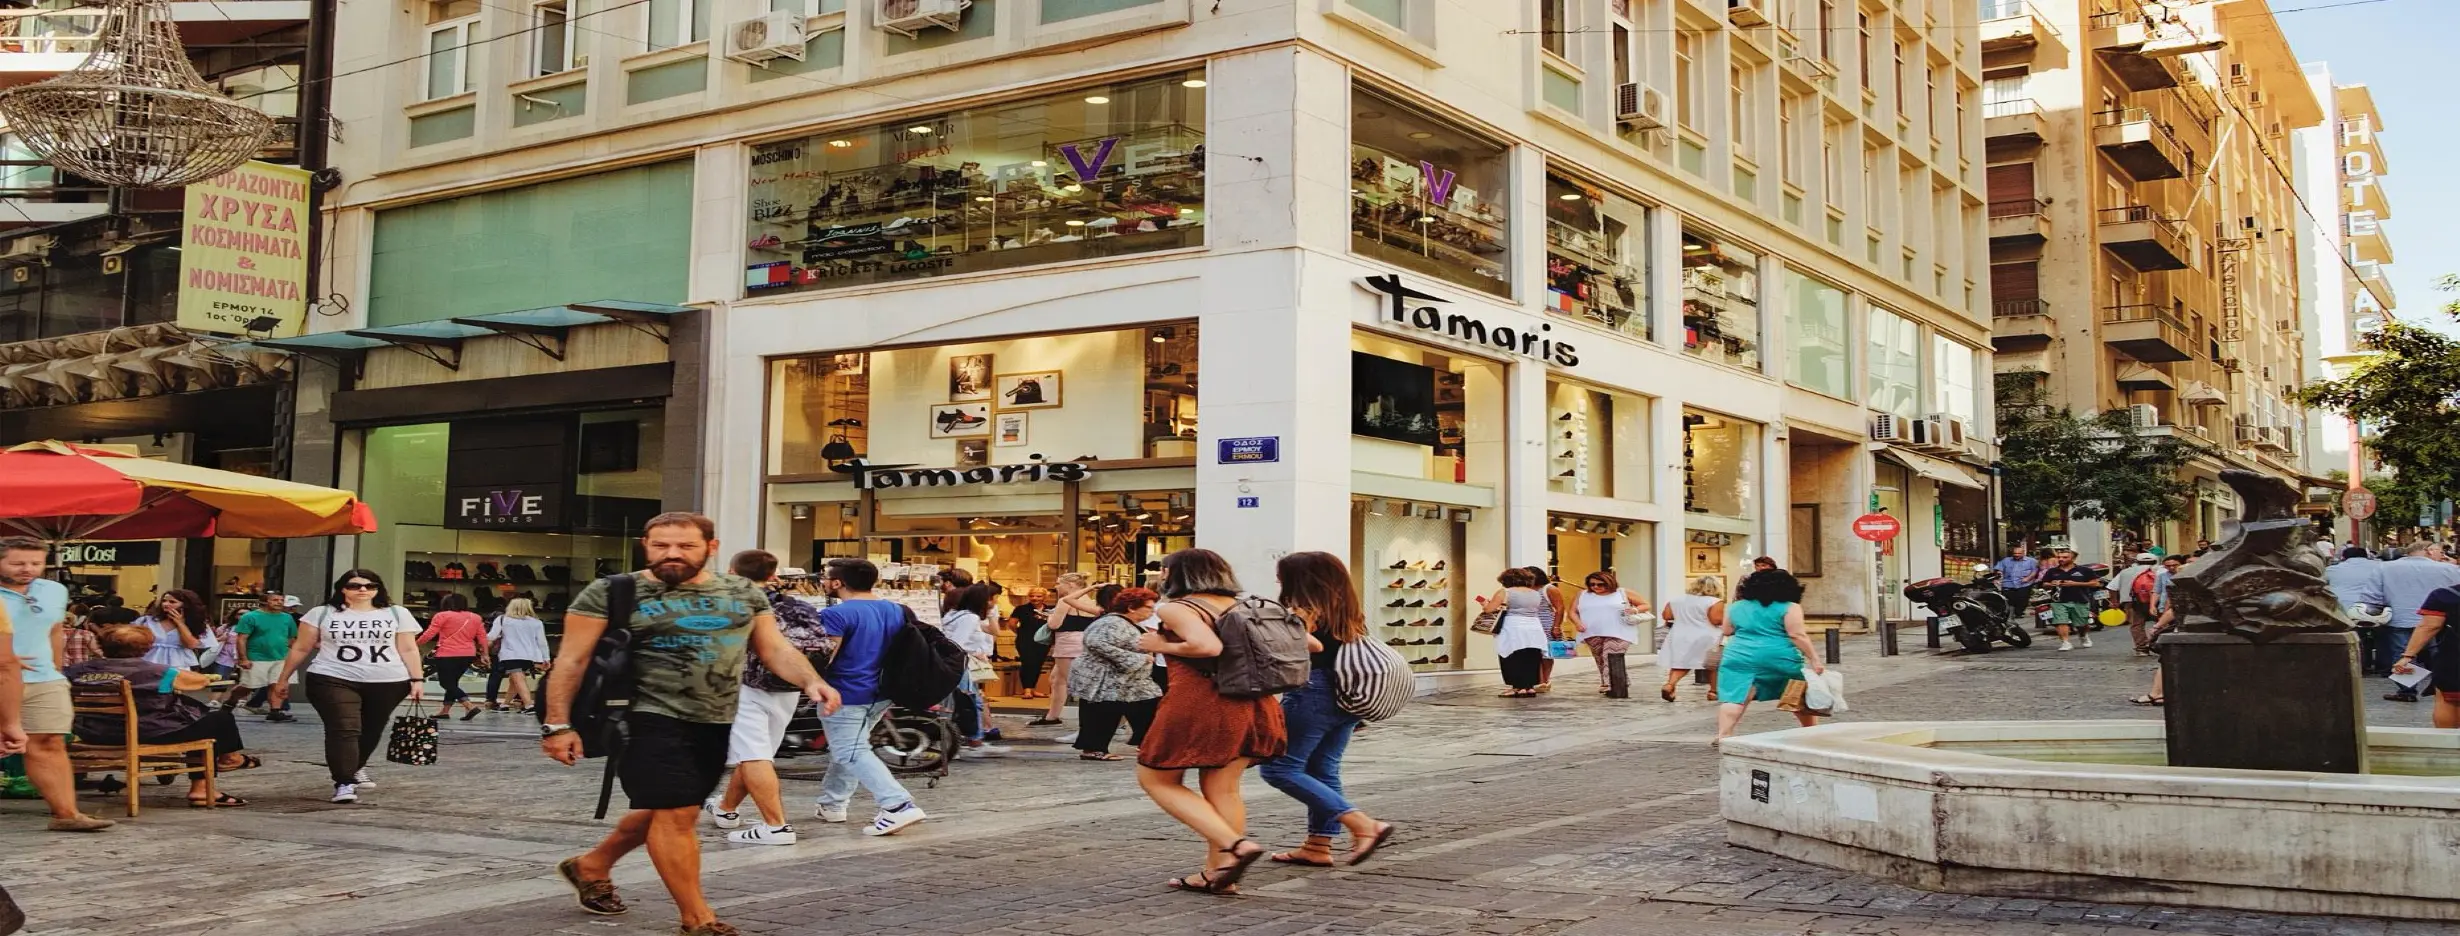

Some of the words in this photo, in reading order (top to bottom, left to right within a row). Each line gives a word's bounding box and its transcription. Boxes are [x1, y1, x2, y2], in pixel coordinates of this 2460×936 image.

[752, 147, 801, 167] MOSCHINO
[2344, 113, 2379, 267] HOTEL
[199, 193, 298, 233] ΧΡΥΣΑ
[754, 204, 793, 222] BIZZ
[191, 224, 302, 260] ΚΟΣΜΗΜΑΤΑ
[237, 256, 257, 271] &
[890, 258, 953, 274] LACOSTE
[189, 267, 300, 301] ΝΟΜΙΣΜΑΤΑ
[213, 301, 257, 313] ΕΡΜΟΥ
[260, 307, 275, 316] 14
[1241, 498, 1253, 506] 12
[471, 516, 533, 524] SHOES
[62, 545, 83, 562] Bill
[84, 545, 117, 562] Cost
[329, 620, 393, 629] EVERY
[328, 630, 392, 639] THING
[336, 645, 391, 663] OK
